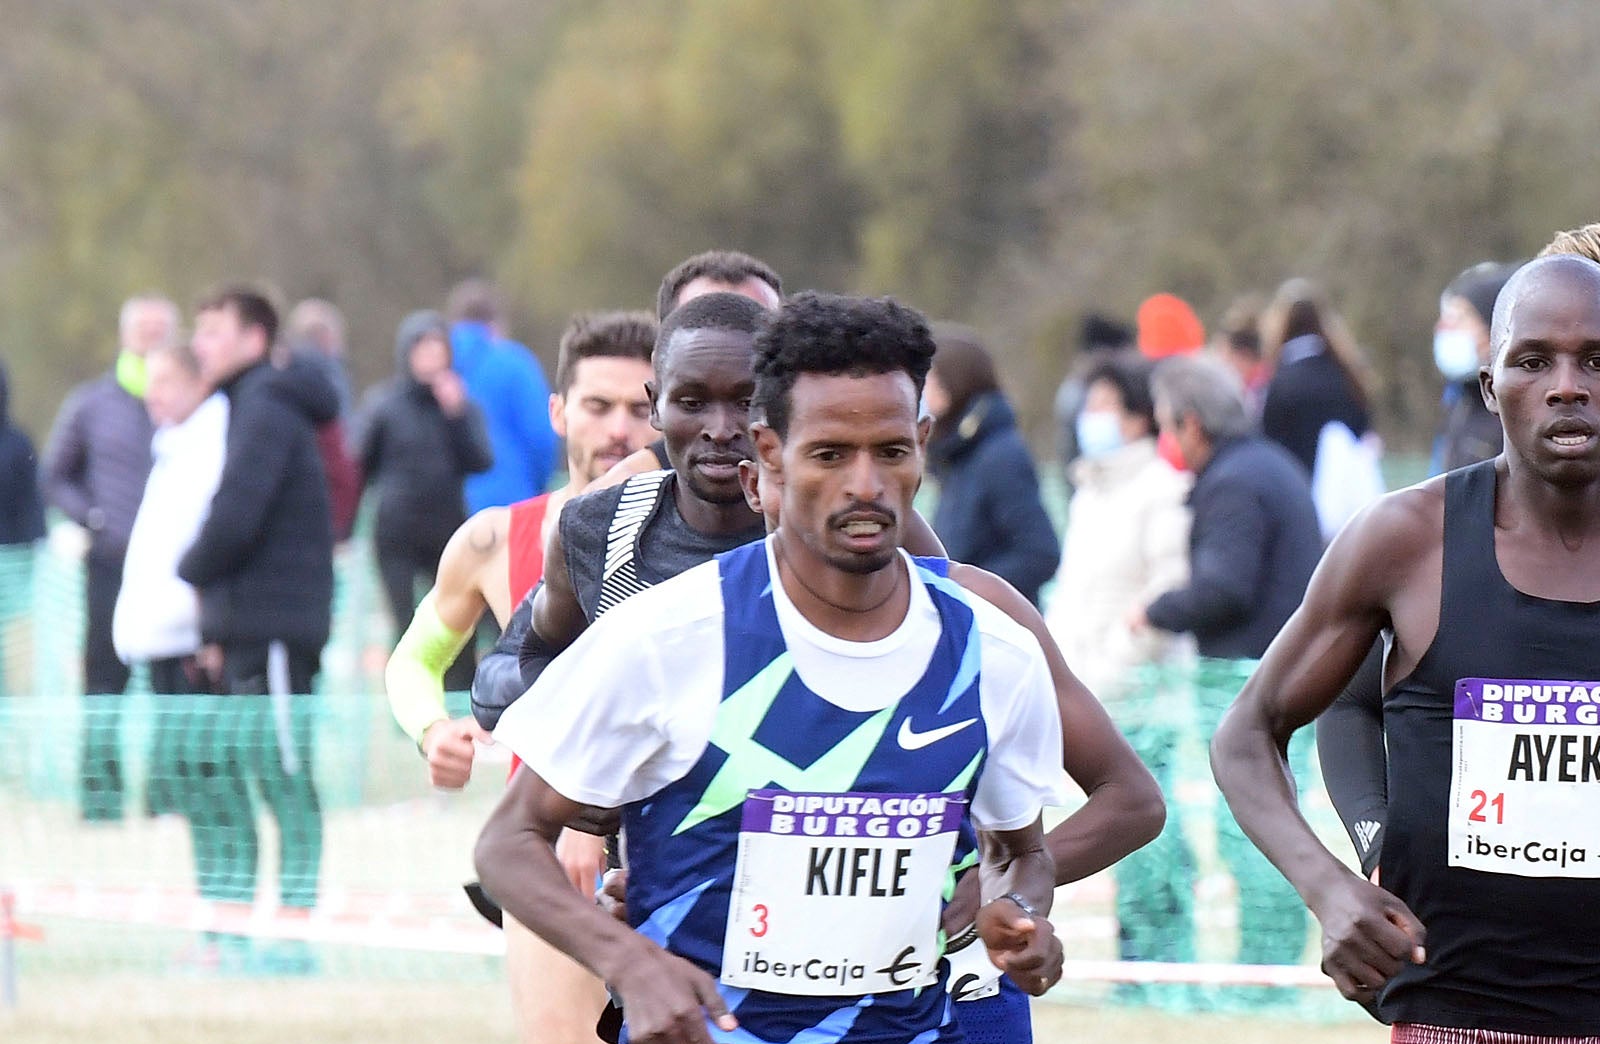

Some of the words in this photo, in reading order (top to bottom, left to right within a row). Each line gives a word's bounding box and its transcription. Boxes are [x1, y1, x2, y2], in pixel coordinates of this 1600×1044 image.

[772, 793, 946, 817] DIPUTACIÓN
[1468, 789, 1505, 825] 21
[770, 813, 944, 837] BURGOS
[1467, 835, 1586, 868] iberCaja
[804, 846, 912, 897] KIFLE
[750, 903, 768, 938] 3
[742, 951, 865, 986] iberCaja
